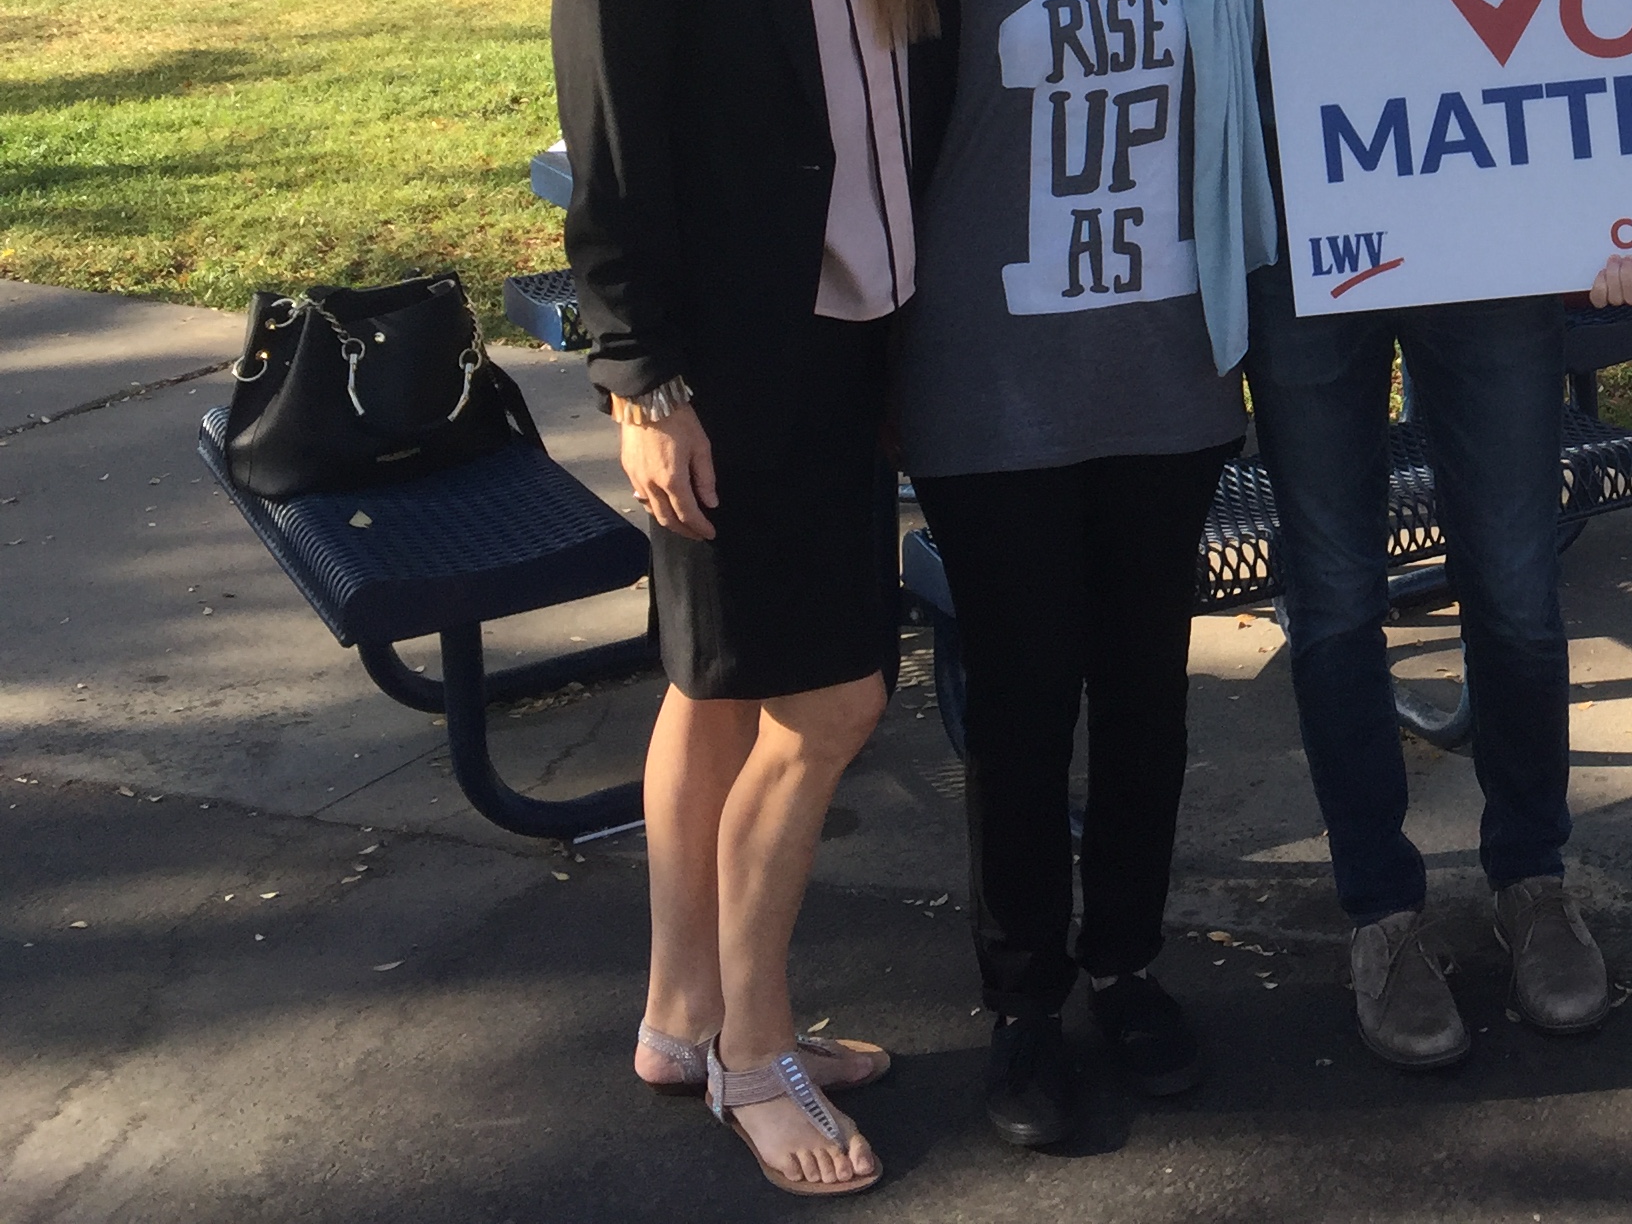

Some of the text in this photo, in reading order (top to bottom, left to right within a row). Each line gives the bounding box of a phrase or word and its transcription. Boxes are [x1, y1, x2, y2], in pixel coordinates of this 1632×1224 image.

[1048, 84, 1169, 197] UP
[1062, 207, 1144, 298] AS
[1309, 232, 1384, 276] LWV
